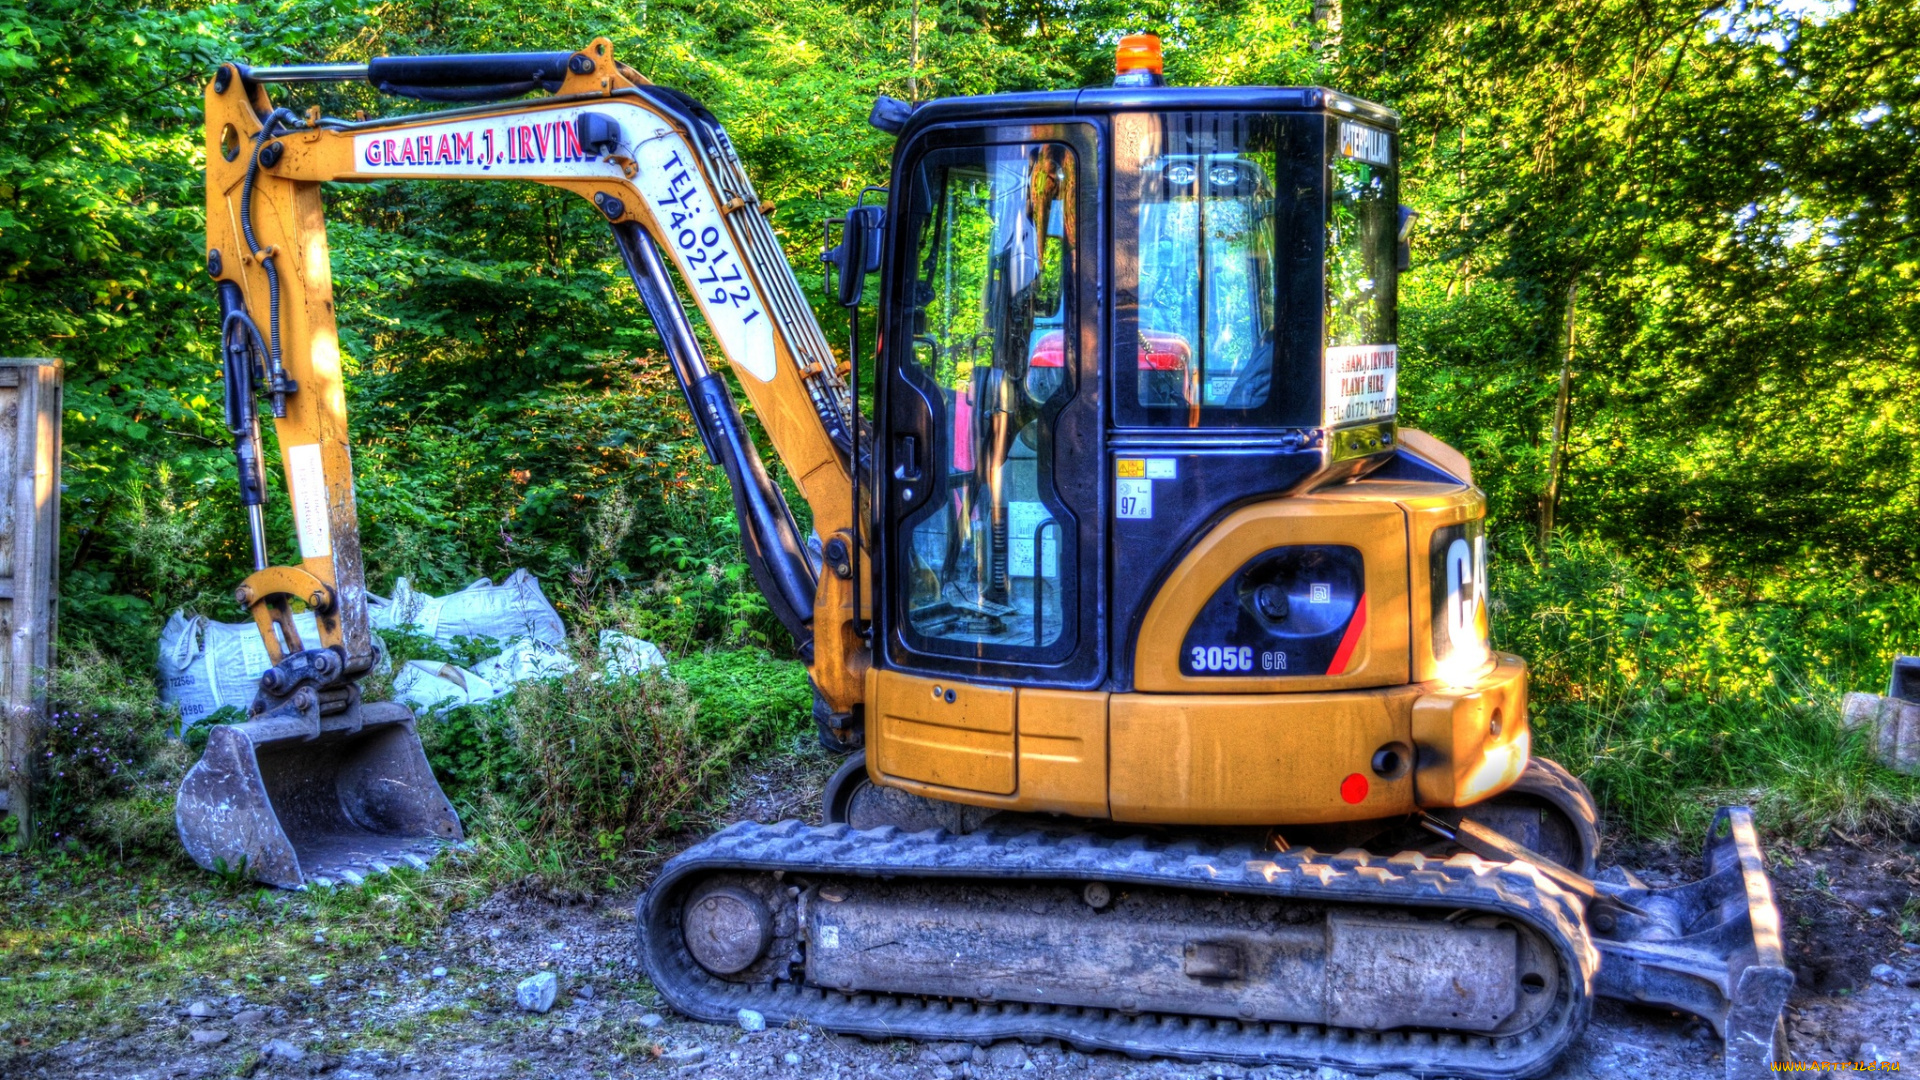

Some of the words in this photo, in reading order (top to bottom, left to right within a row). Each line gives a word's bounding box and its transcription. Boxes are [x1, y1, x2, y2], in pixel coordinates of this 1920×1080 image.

[508, 120, 598, 163] IRVIN
[658, 187, 728, 304] 740279
[701, 226, 760, 324] 01721
[1341, 376, 1365, 397] PLANT
[1367, 374, 1384, 394] HIRE
[1346, 401, 1368, 419] 01721
[1121, 496, 1137, 515] 97
[1191, 646, 1253, 670] 305C
[1261, 651, 1287, 670] CR
